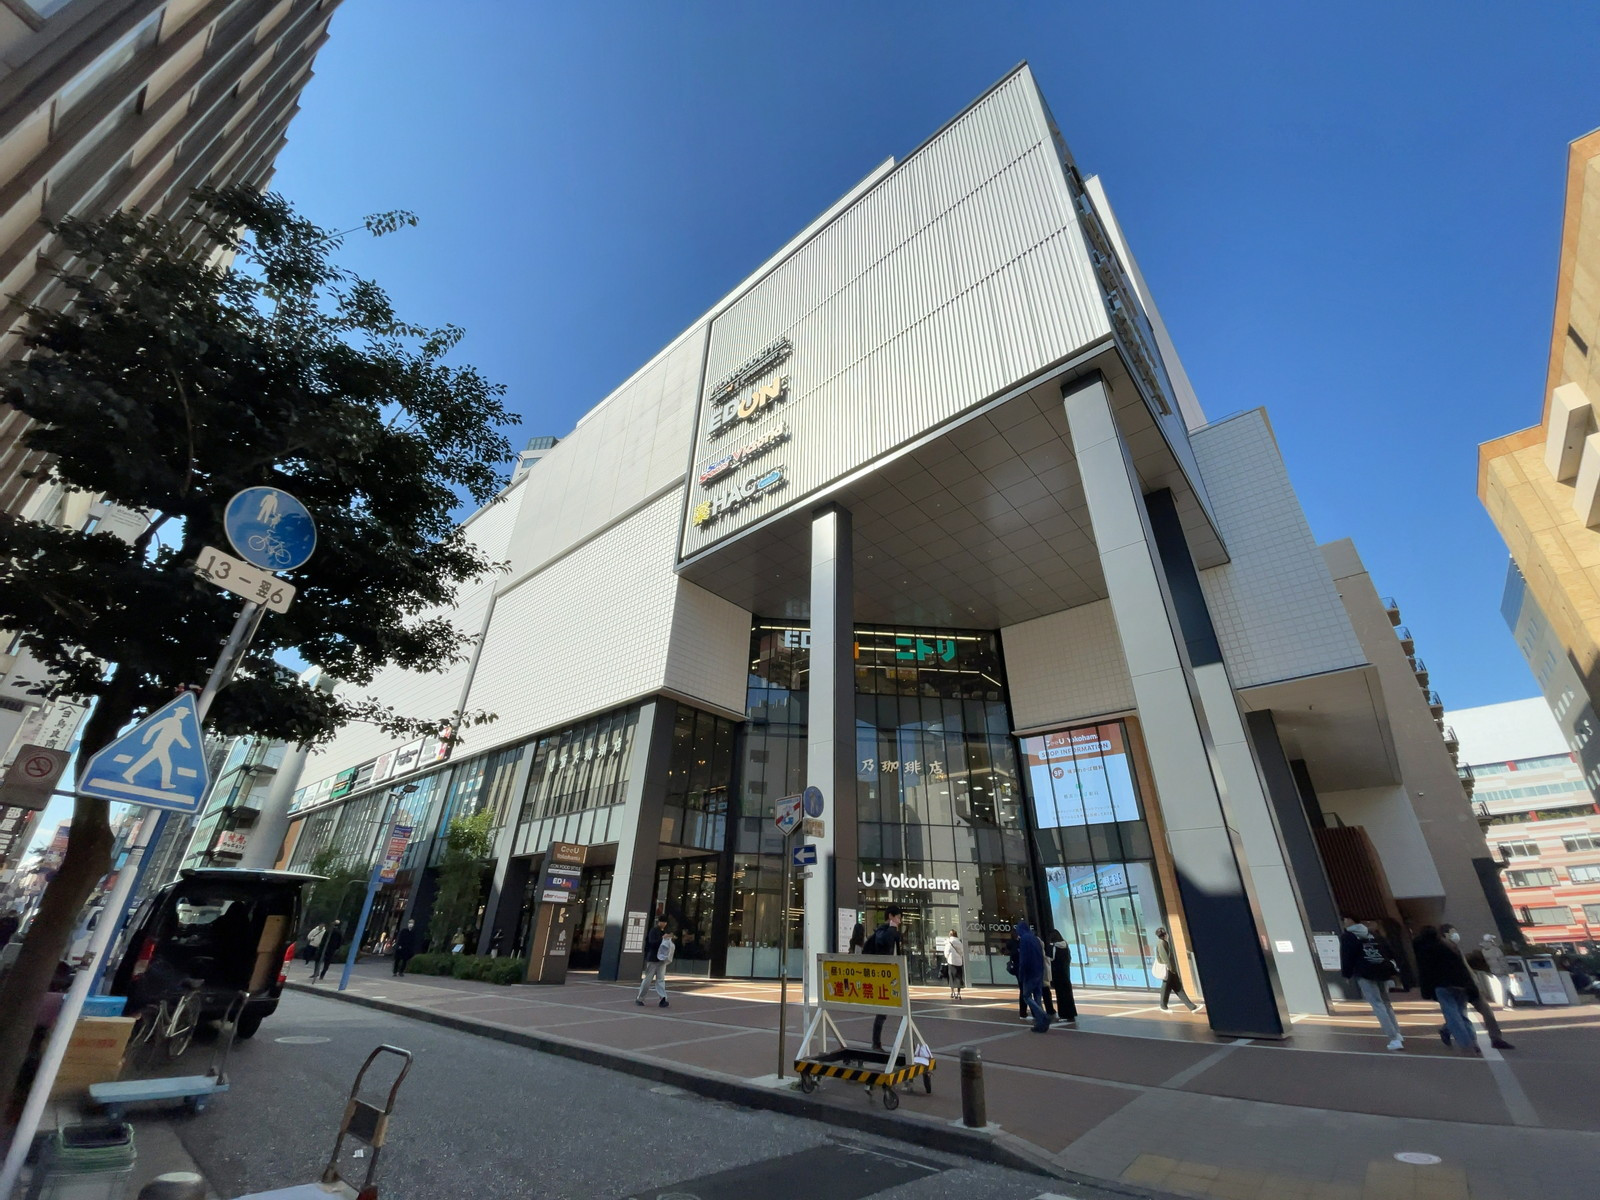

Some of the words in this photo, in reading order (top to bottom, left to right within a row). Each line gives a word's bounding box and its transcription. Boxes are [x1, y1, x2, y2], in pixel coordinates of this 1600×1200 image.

[896, 638, 955, 662] ニトリ
[882, 872, 960, 891] Yokohama
[989, 923, 1011, 932] FOOD
[834, 981, 890, 1000] 進入禁止
